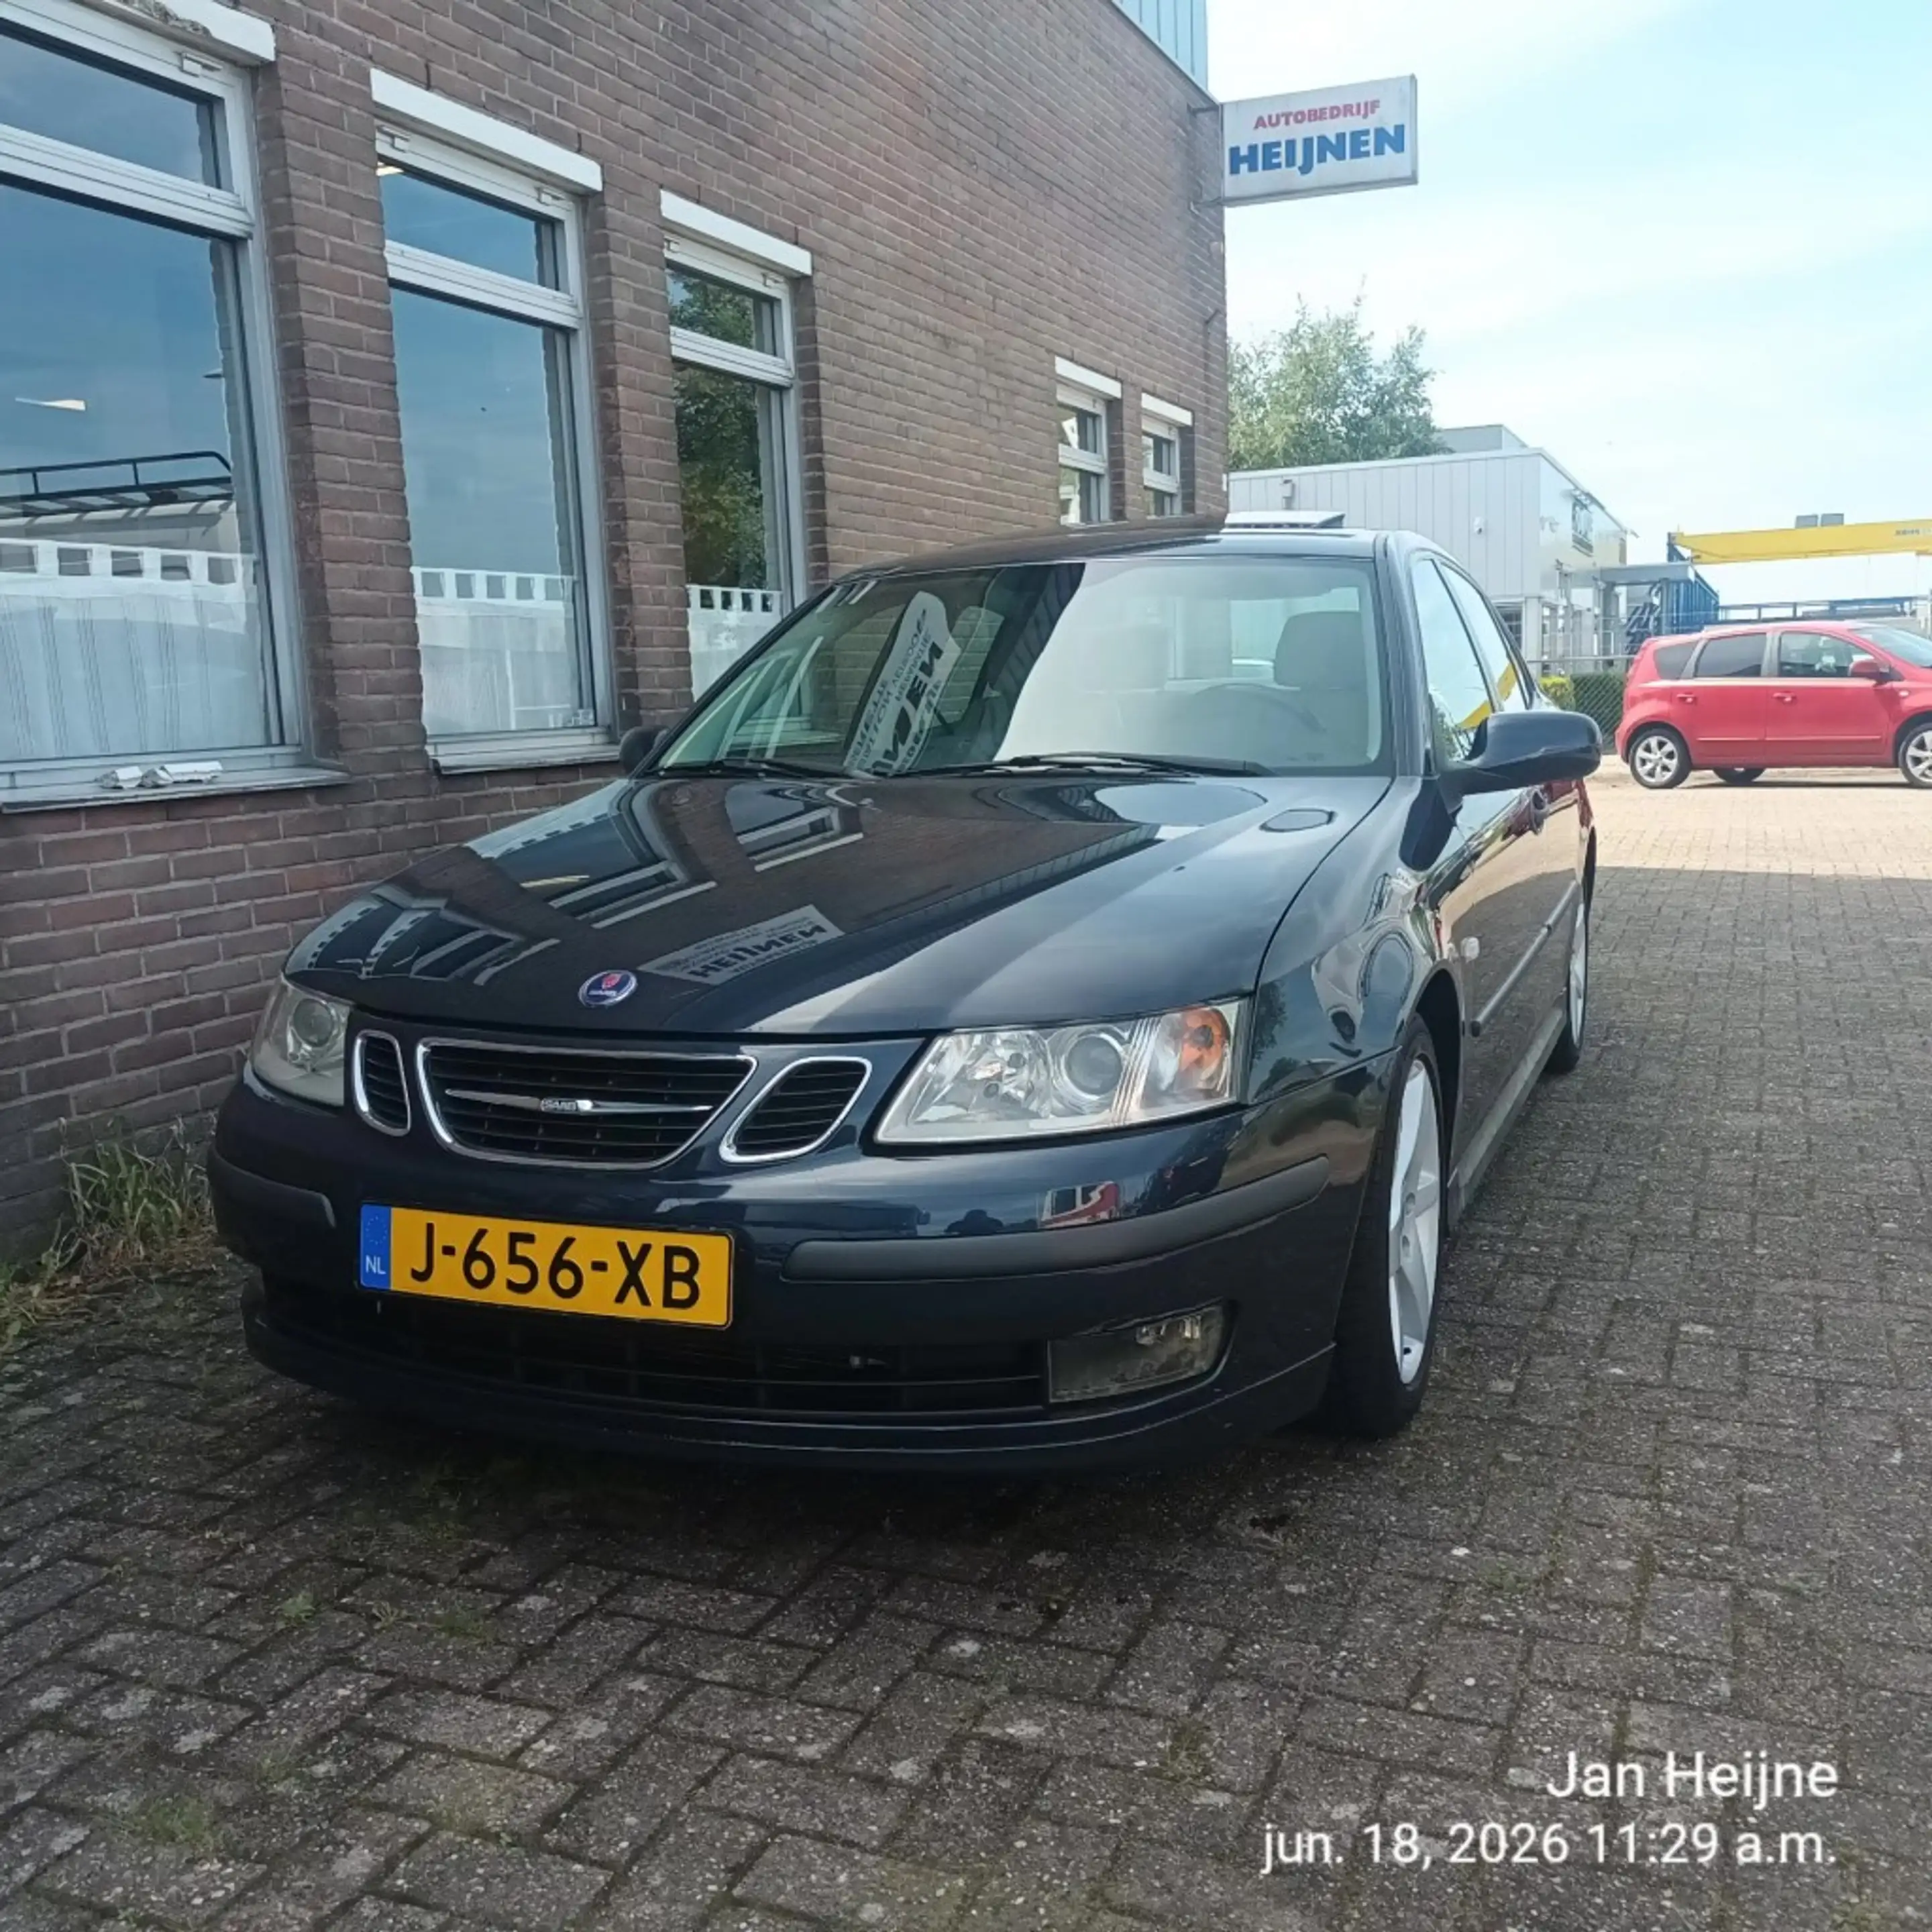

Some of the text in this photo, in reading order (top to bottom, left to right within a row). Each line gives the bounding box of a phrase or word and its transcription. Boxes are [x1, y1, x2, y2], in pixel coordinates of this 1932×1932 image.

[1253, 100, 1380, 129] AUTOBEDRIJF
[1228, 124, 1405, 175] HEIJNEN
[365, 1256, 386, 1275] NL
[411, 1222, 701, 1309] J-656-XB
